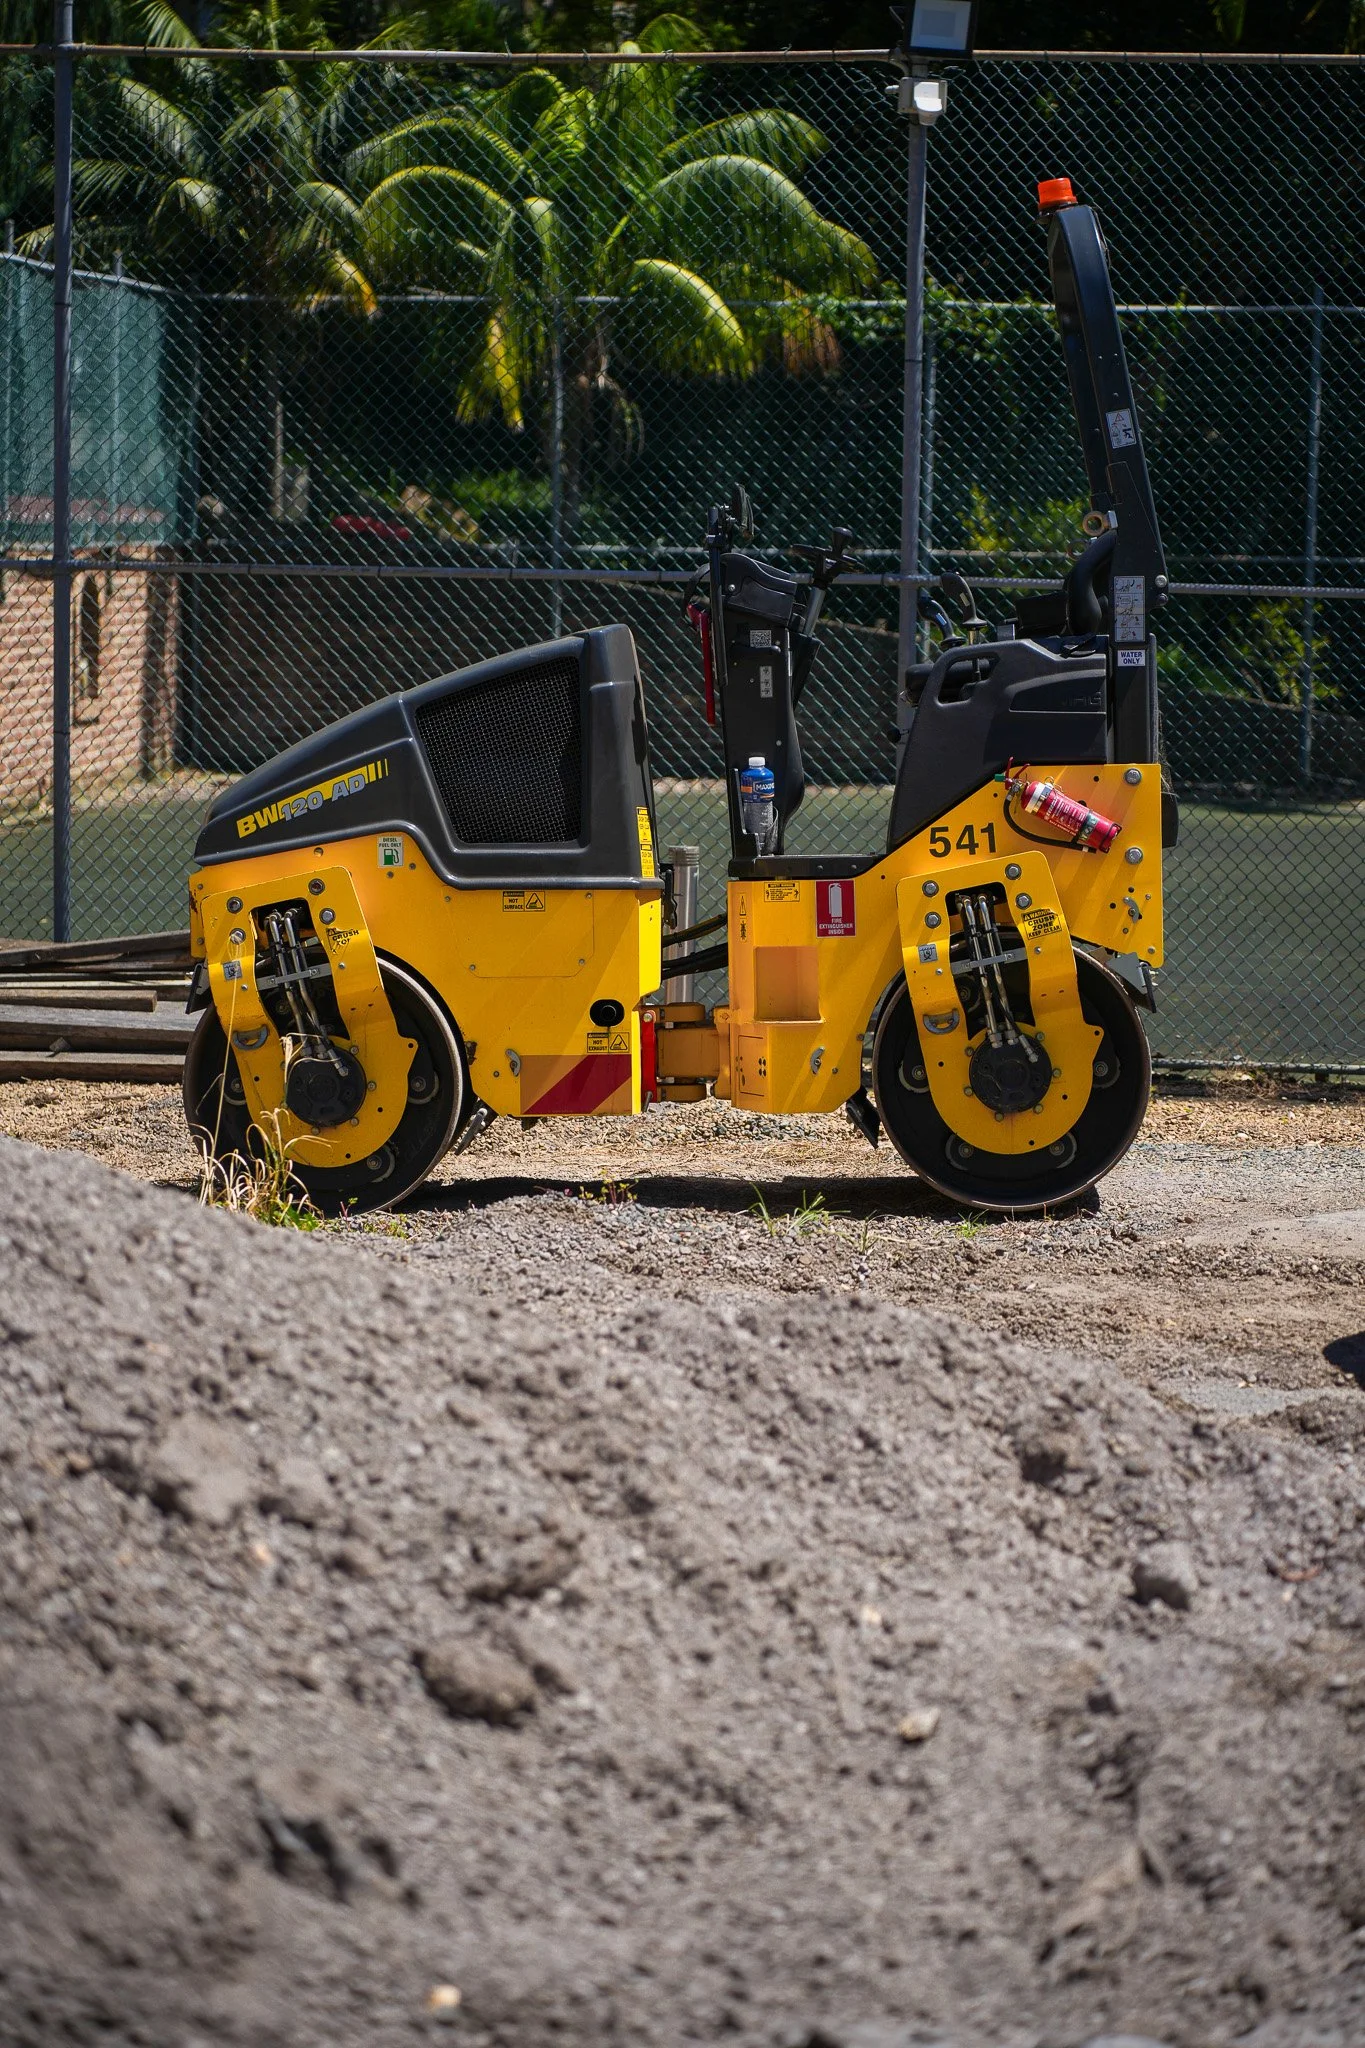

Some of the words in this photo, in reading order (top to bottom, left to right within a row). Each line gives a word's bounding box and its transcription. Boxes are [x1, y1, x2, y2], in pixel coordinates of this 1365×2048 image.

[331, 773, 367, 802] AD
[929, 822, 997, 858] 541
[1028, 915, 1055, 926] CRUSH
[1033, 921, 1053, 931] ZONE
[332, 929, 359, 941] CRUSH
[1044, 925, 1060, 934] CLEAR
